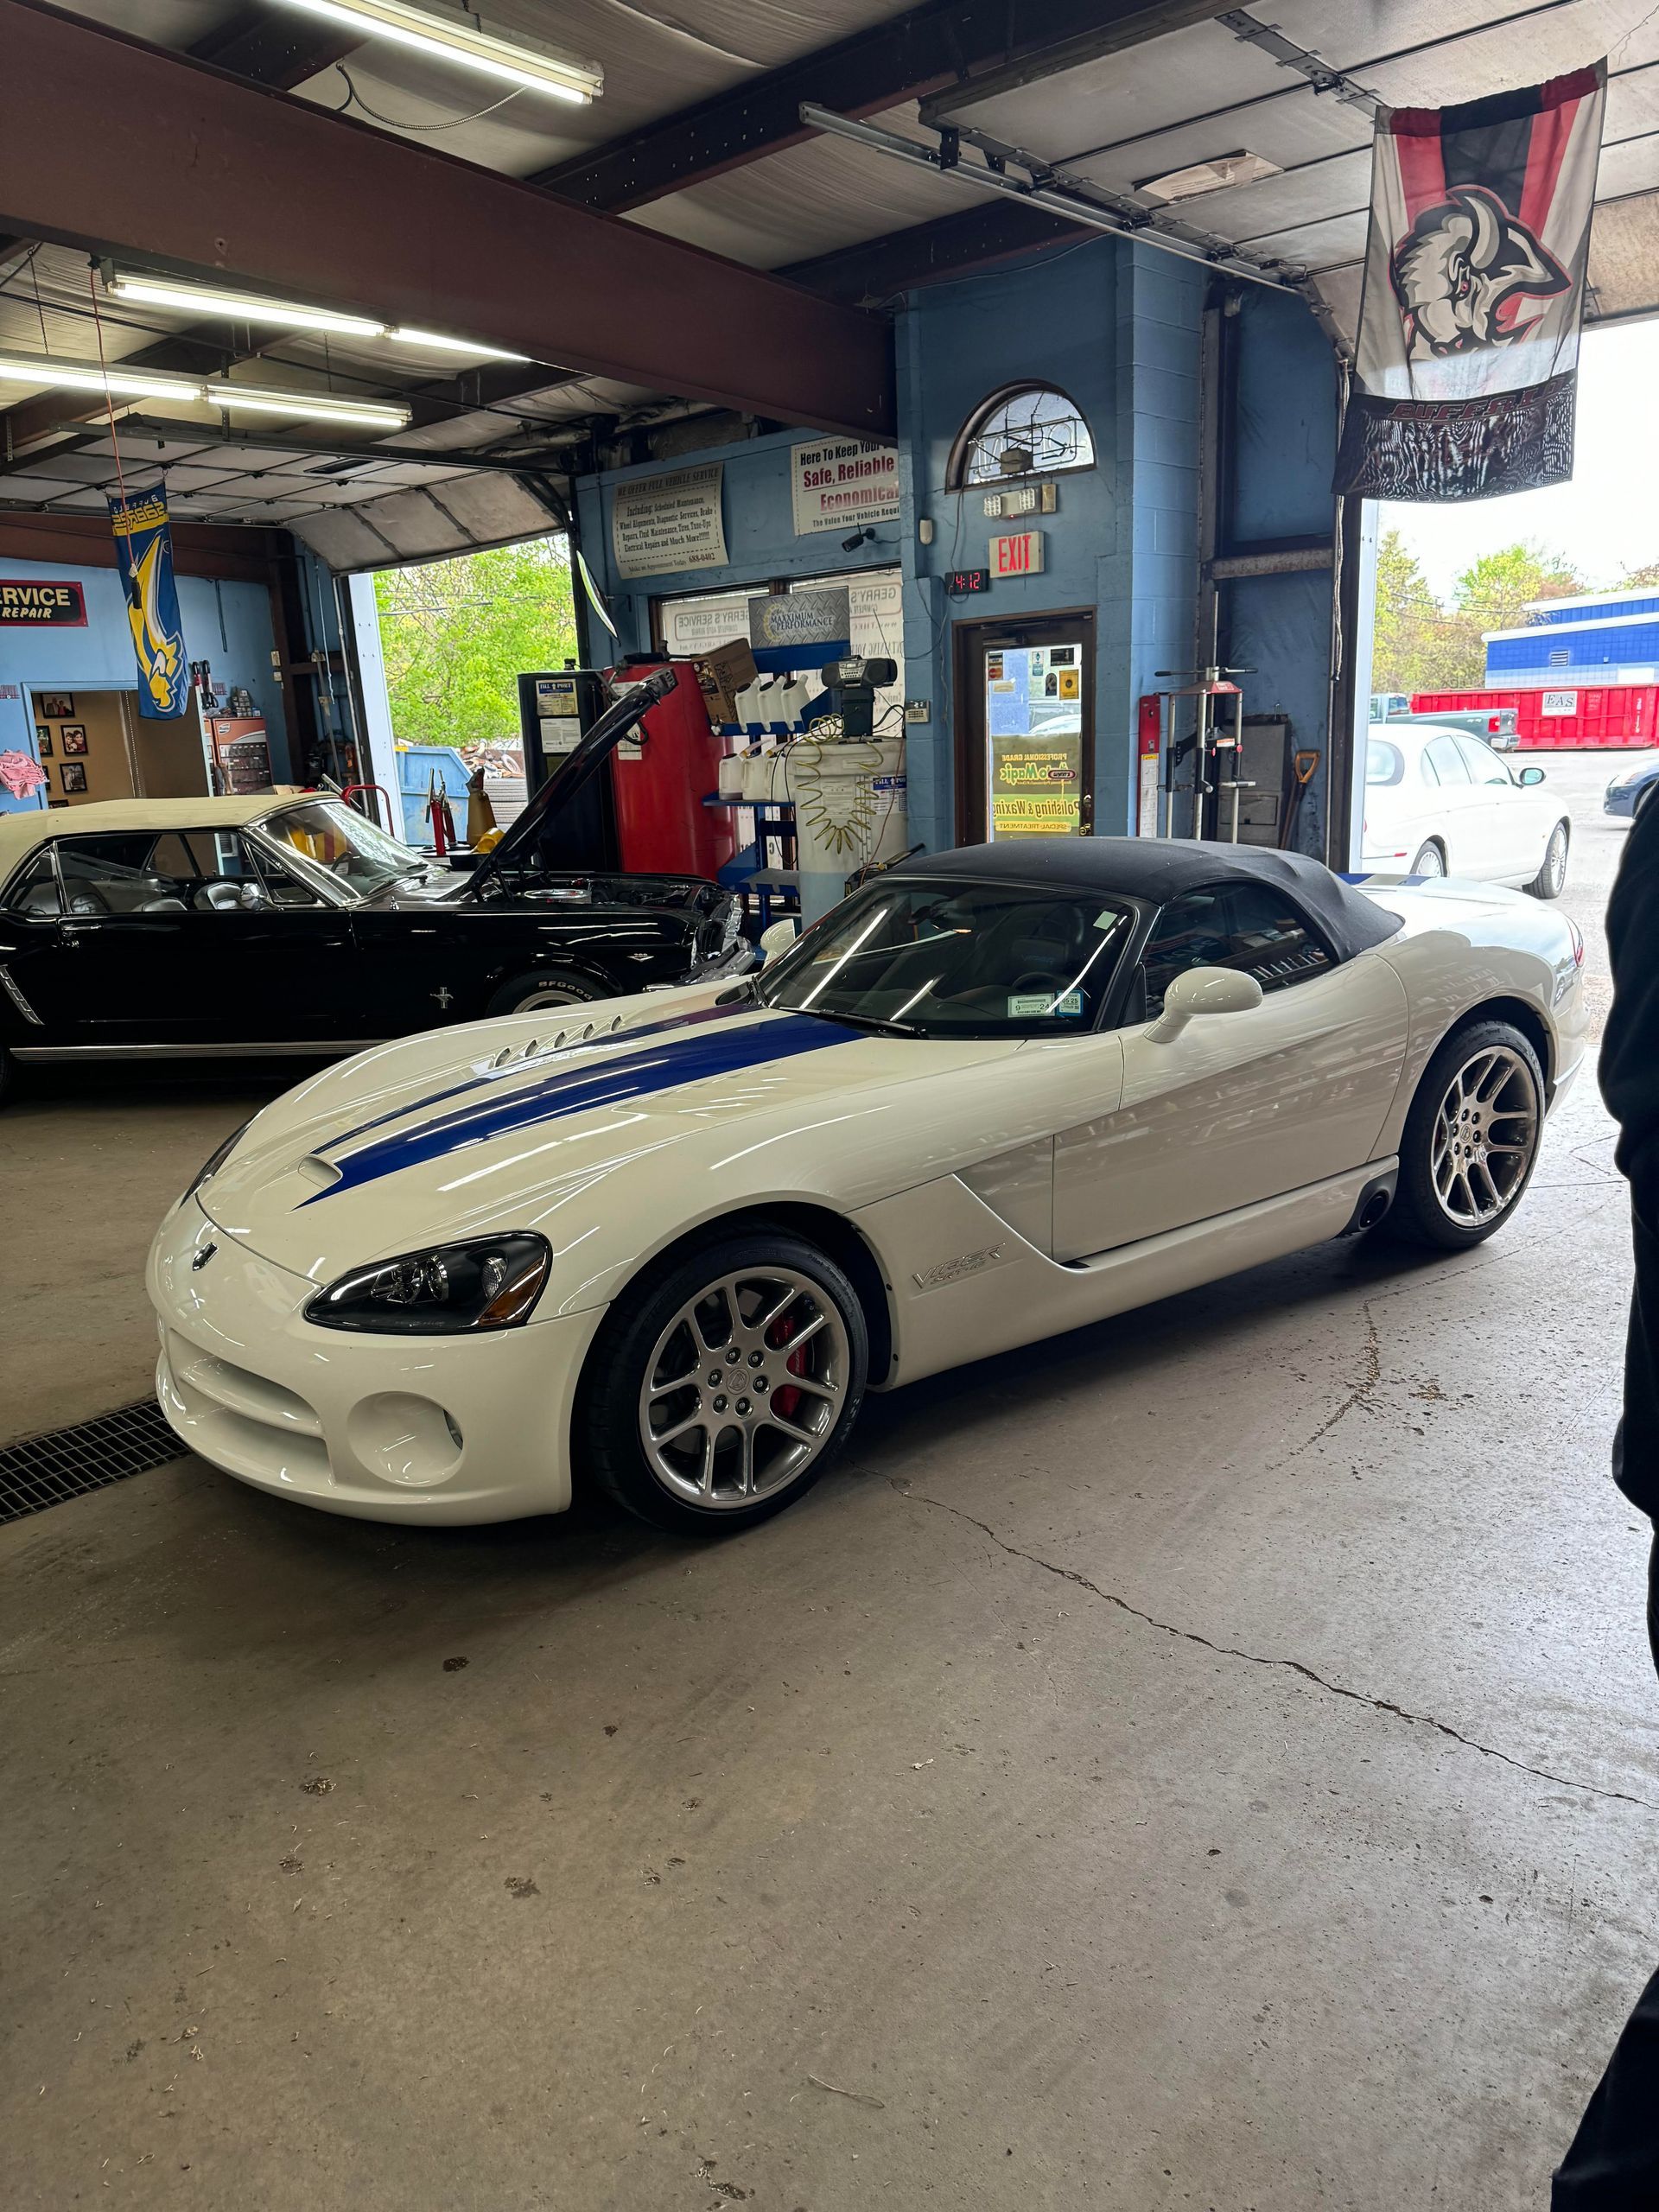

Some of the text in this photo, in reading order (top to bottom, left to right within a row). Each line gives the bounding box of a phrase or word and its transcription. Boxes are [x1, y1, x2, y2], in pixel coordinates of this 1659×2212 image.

[1389, 377, 1567, 421] BUFFALO
[800, 440, 880, 466] Here To Keep Your
[804, 455, 895, 488] Safe, Reliable
[618, 467, 719, 497] WE OFFER FULL VEHICLE SERVICE
[626, 497, 705, 517] Including: Scheduled Maintenance,
[820, 485, 899, 512] Economical
[620, 506, 713, 531] Wheel Alignments, Diagnostic Services, Brake
[856, 511, 880, 519] Vehicle
[622, 532, 639, 542] Repairs,
[639, 529, 650, 538] Fluid
[651, 526, 678, 537] Maintenance,
[690, 519, 711, 530] Tune-Ups
[624, 542, 644, 552] Electrical
[645, 540, 660, 550] Repairs
[670, 536, 684, 545] Much
[999, 534, 1032, 573] EXIT
[689, 552, 715, 563] 688-0402
[956, 572, 981, 589] 4:12
[0, 588, 71, 607] RVICE
[2, 607, 52, 619] REPAIR
[772, 612, 814, 623] MAXXIMUM
[777, 616, 834, 631] PERFORMANCE
[1547, 694, 1573, 708] EAS
[808, 1253, 824, 1267] Pilot
